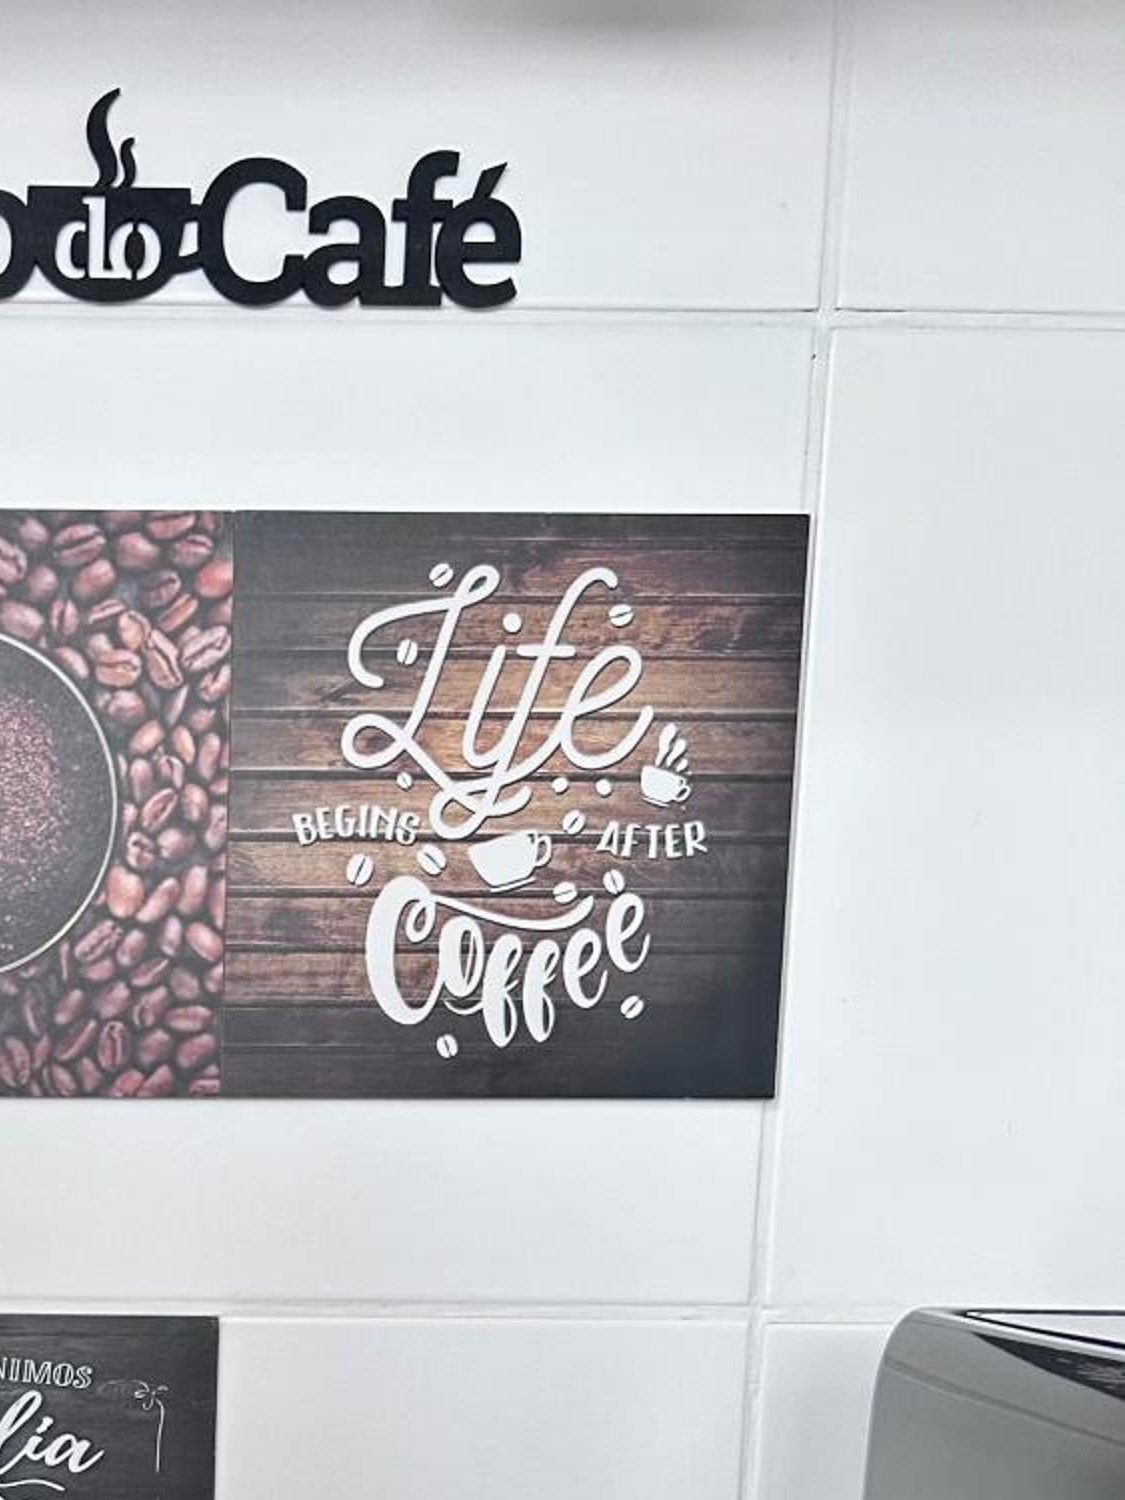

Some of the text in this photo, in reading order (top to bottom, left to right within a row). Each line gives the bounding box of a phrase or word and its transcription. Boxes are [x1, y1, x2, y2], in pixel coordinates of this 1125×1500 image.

[55, 196, 163, 284] do
[200, 149, 521, 310] Café
[341, 564, 654, 839] Life
[292, 804, 708, 859] BEGINS AFTER
[365, 875, 650, 1047] Coffee
